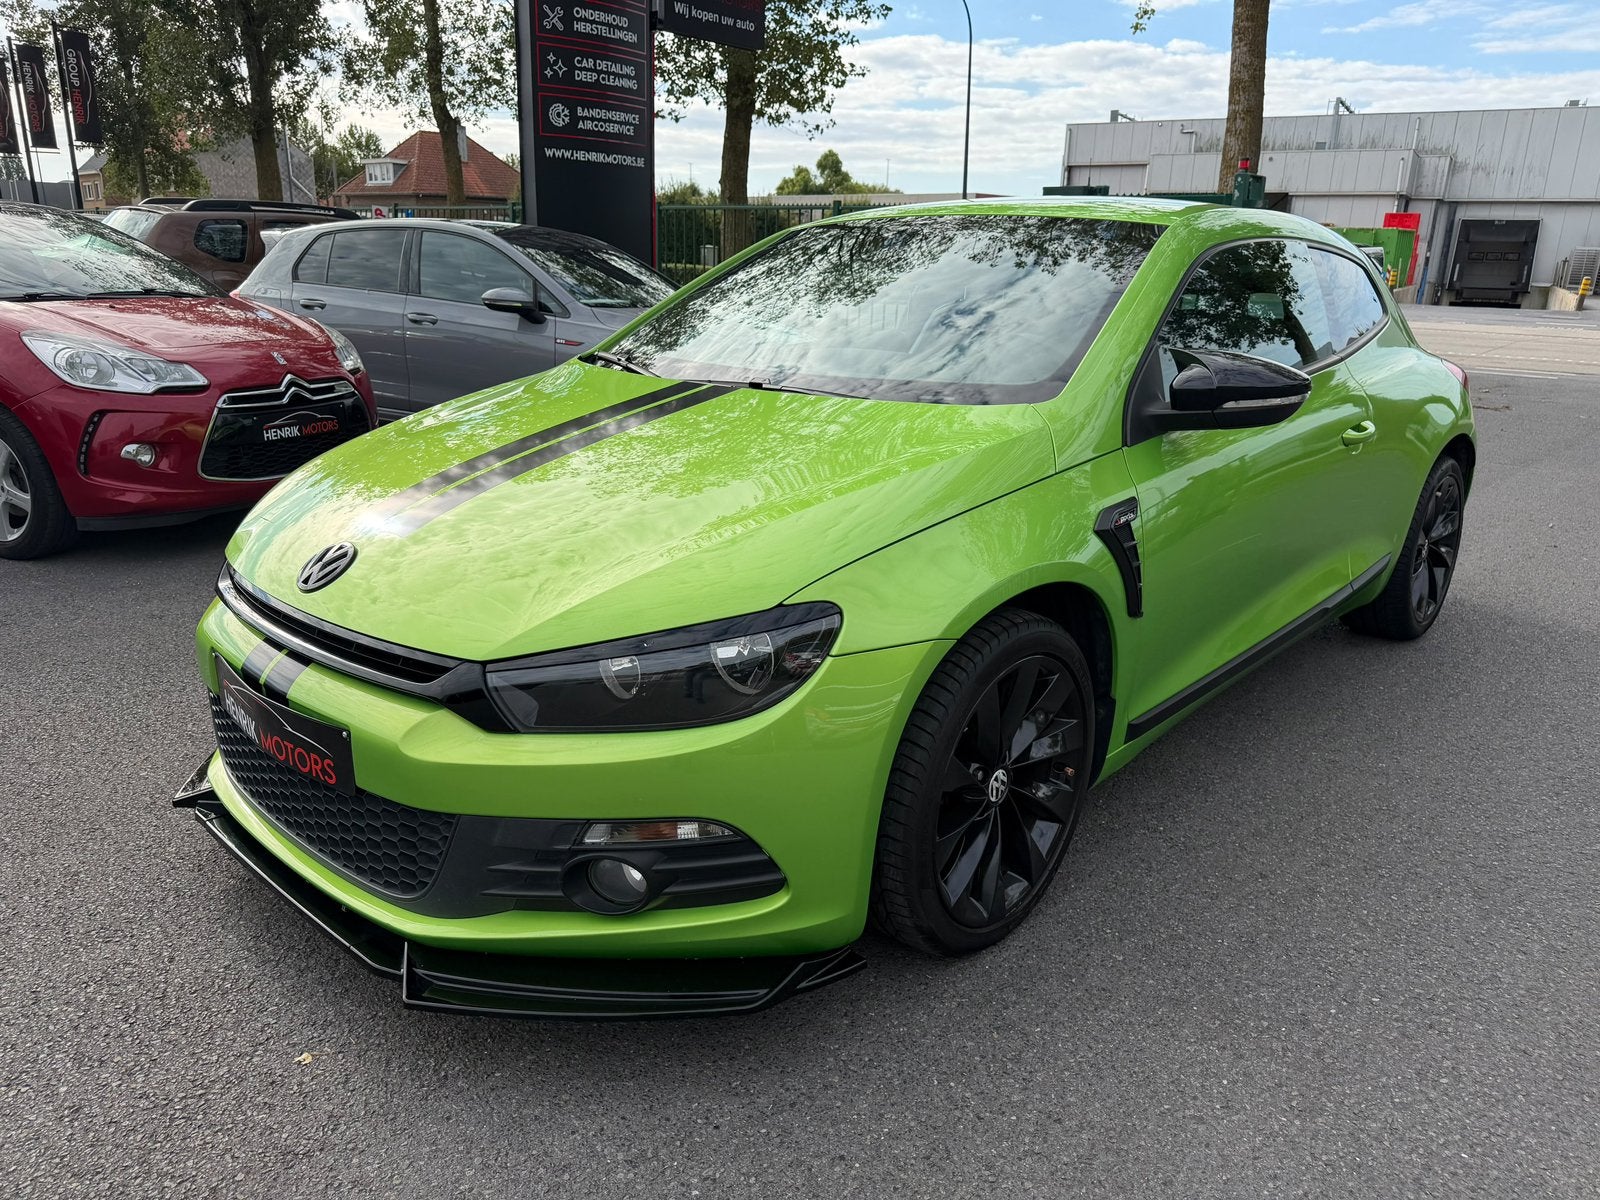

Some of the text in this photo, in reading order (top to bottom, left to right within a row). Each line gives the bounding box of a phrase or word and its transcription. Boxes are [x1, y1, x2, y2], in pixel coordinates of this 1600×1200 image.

[573, 7, 629, 28] ONDERHOUD
[674, 1, 689, 19] Wij
[691, 6, 719, 23] kopen
[721, 15, 735, 26] uw
[736, 19, 755, 31] auto
[573, 21, 638, 43] HERSTELLINGEN
[574, 56, 636, 77] CAR DETAILING
[22, 61, 35, 94] HENRIK
[66, 48, 86, 125] GROUP HENRIK
[574, 70, 638, 91] DEEP CLEANING
[577, 106, 640, 125] BANDENSERVICE
[577, 120, 635, 136] AIRCOSERVICE
[544, 147, 645, 168] WWW.HENRIKMOTORS.BE
[263, 419, 339, 441] HENRIK MOTORS
[224, 689, 337, 785] HENRIK MOTORS
